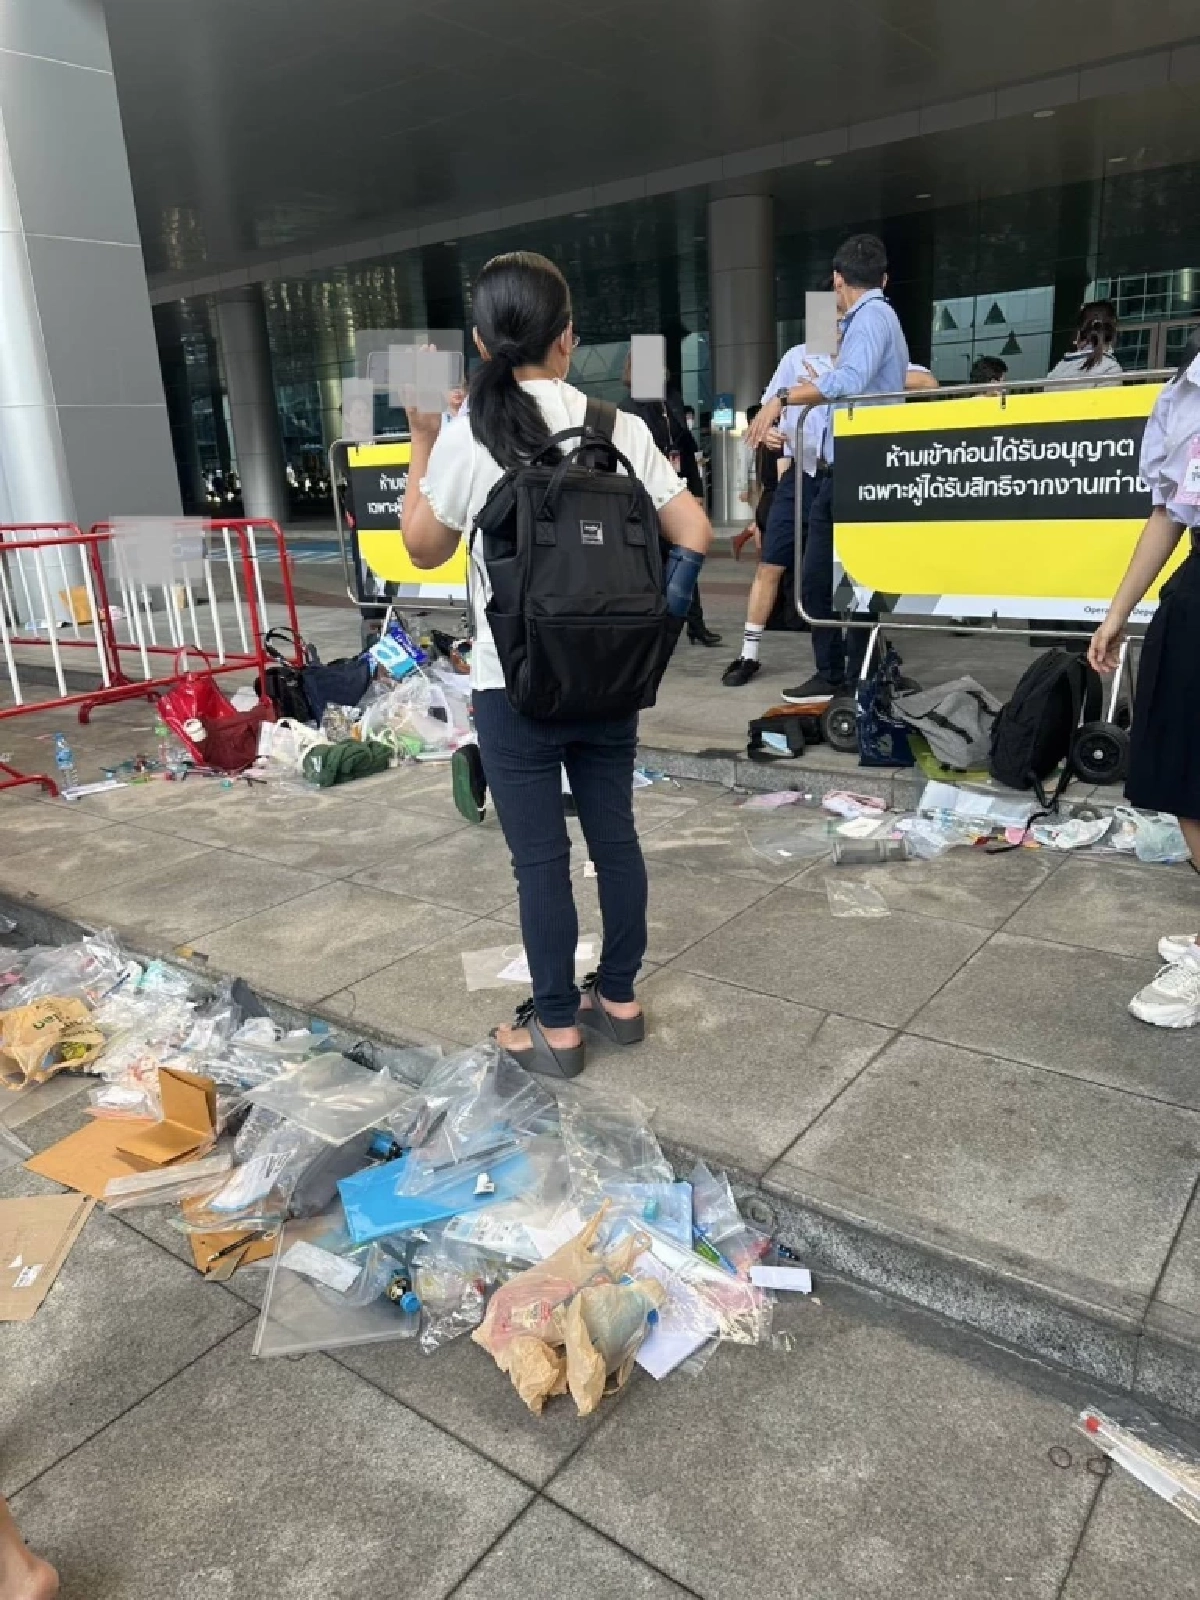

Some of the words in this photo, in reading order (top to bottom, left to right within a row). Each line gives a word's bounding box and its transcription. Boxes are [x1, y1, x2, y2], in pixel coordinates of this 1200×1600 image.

[886, 436, 1135, 467] ห้ามเข้าก่อนได้รับอนุญาต
